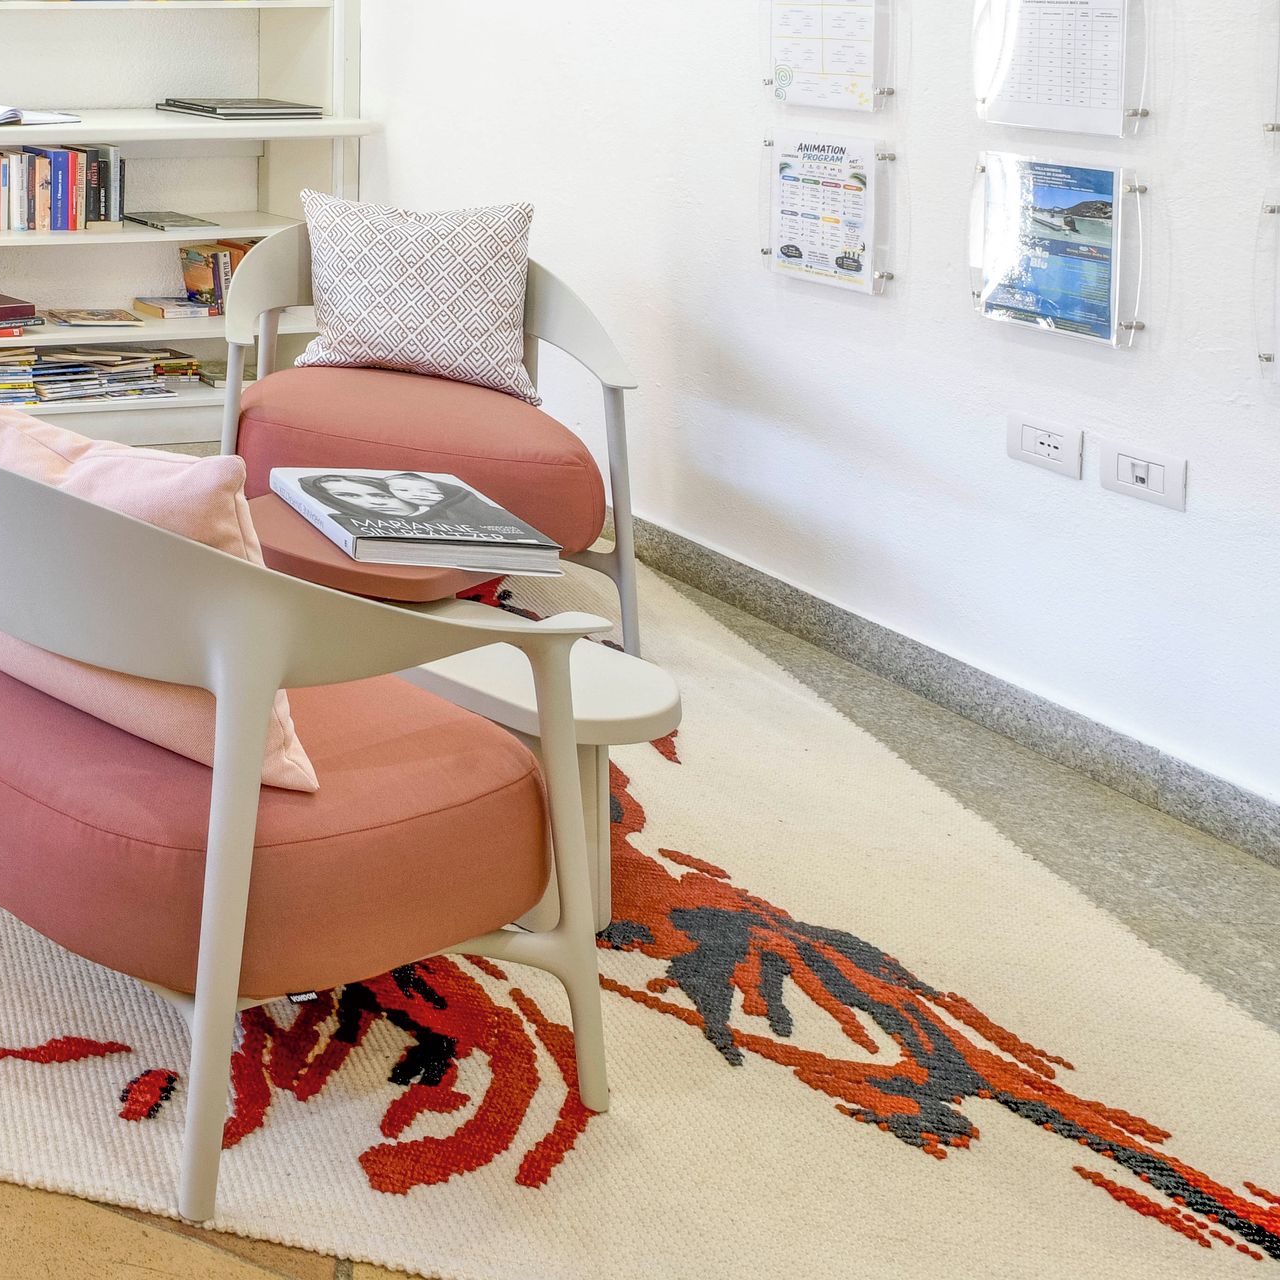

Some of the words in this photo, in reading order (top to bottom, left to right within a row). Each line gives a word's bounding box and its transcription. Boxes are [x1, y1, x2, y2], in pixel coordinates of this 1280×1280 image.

[797, 143, 846, 155] ANIMATION
[802, 153, 843, 163] PROGRAM
[350, 518, 480, 534] MARIANNE
